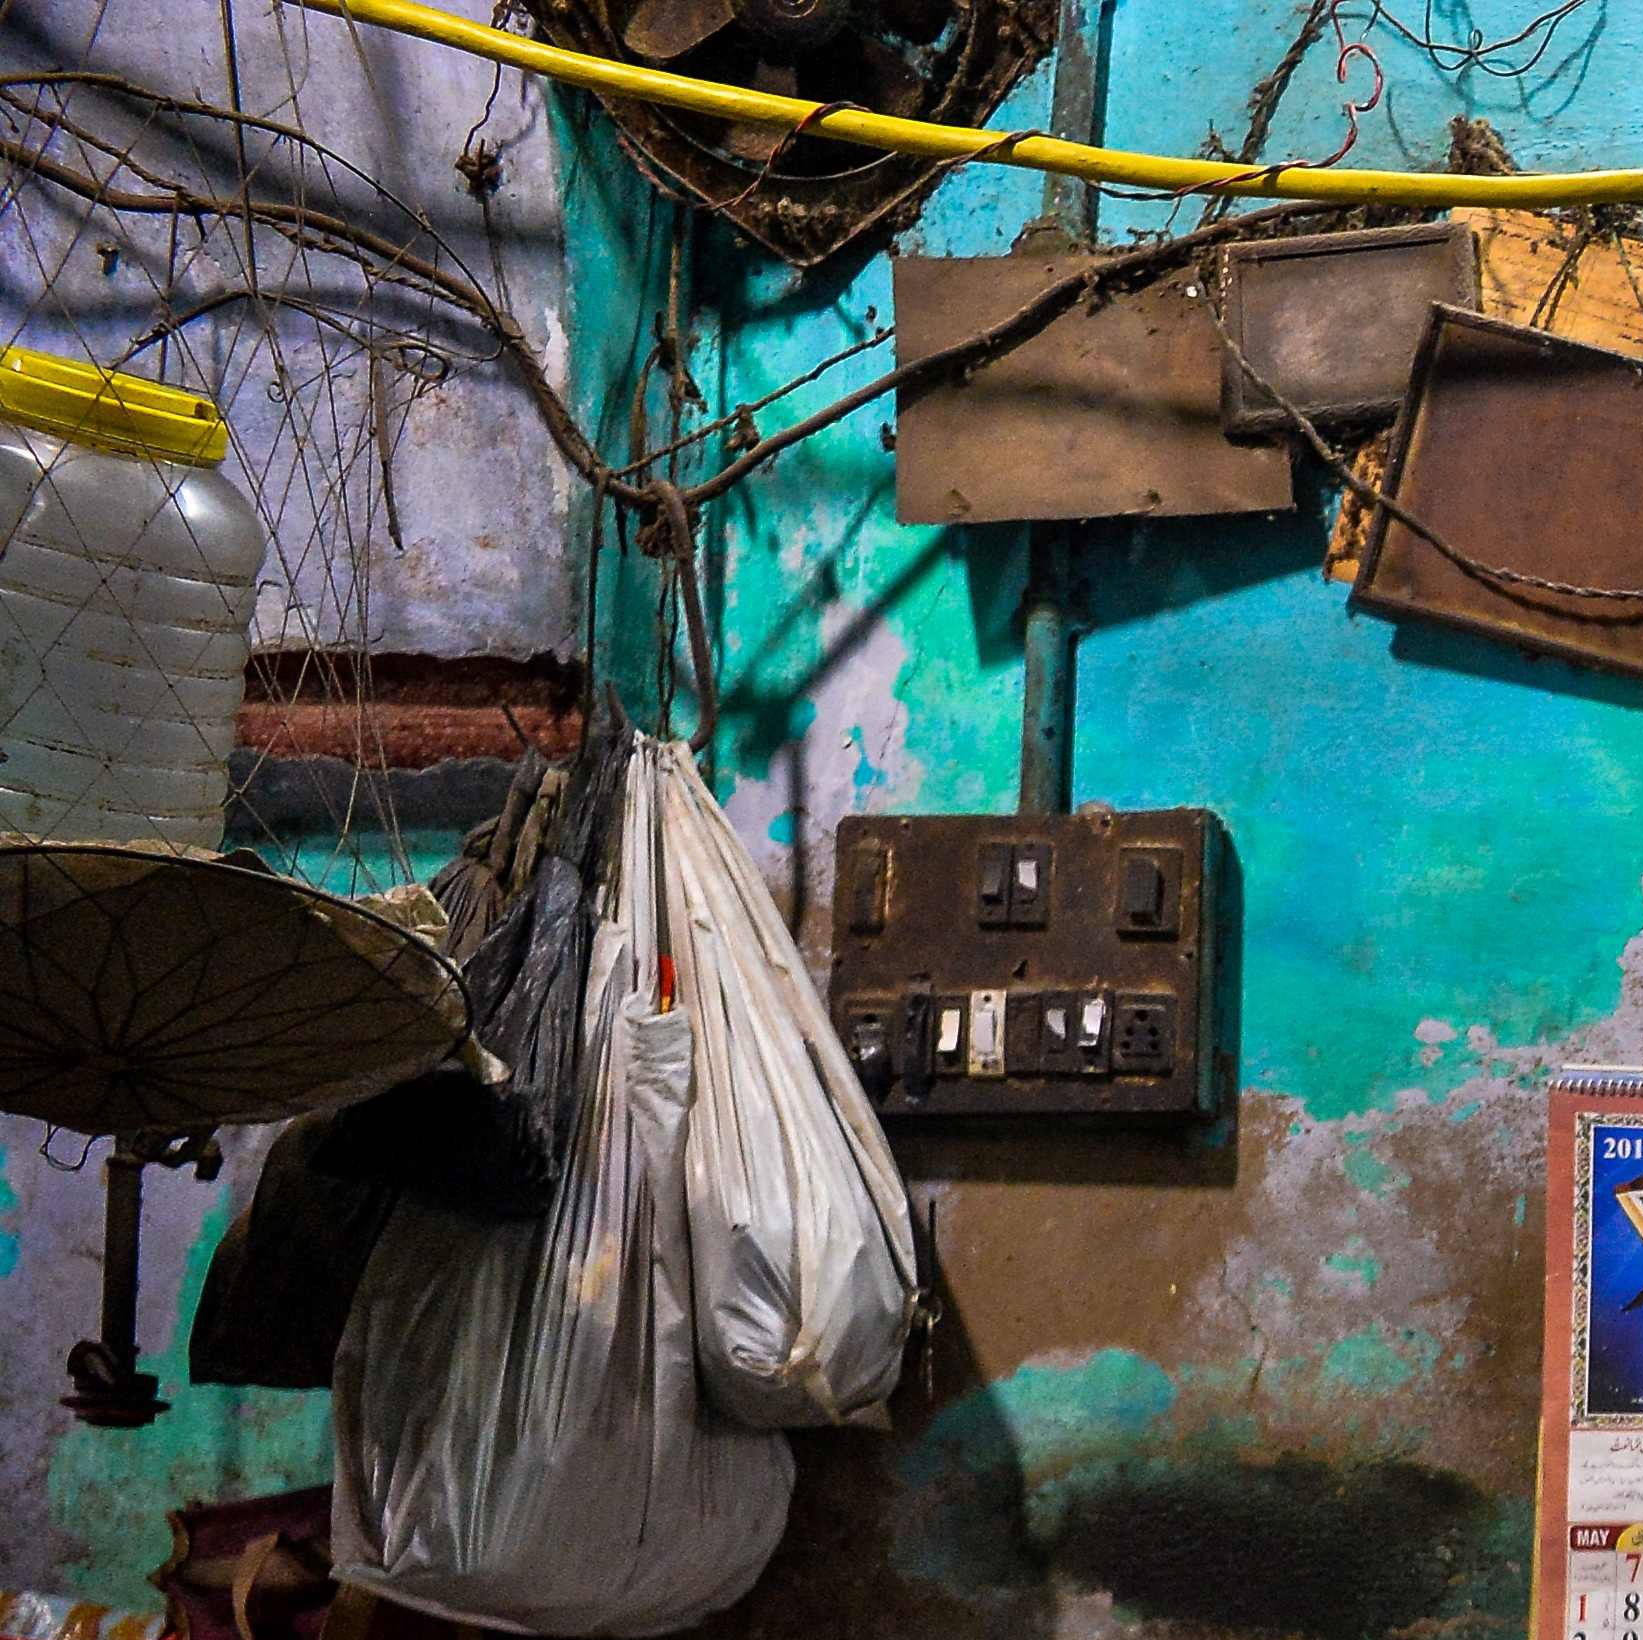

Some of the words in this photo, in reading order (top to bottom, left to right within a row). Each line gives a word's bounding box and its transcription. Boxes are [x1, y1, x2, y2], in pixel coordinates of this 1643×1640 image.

[1576, 1529, 1609, 1546] MAY
[1625, 1554, 1642, 1582] 7
[1578, 1594, 1587, 1622] 1
[1623, 1592, 1640, 1621] 8
